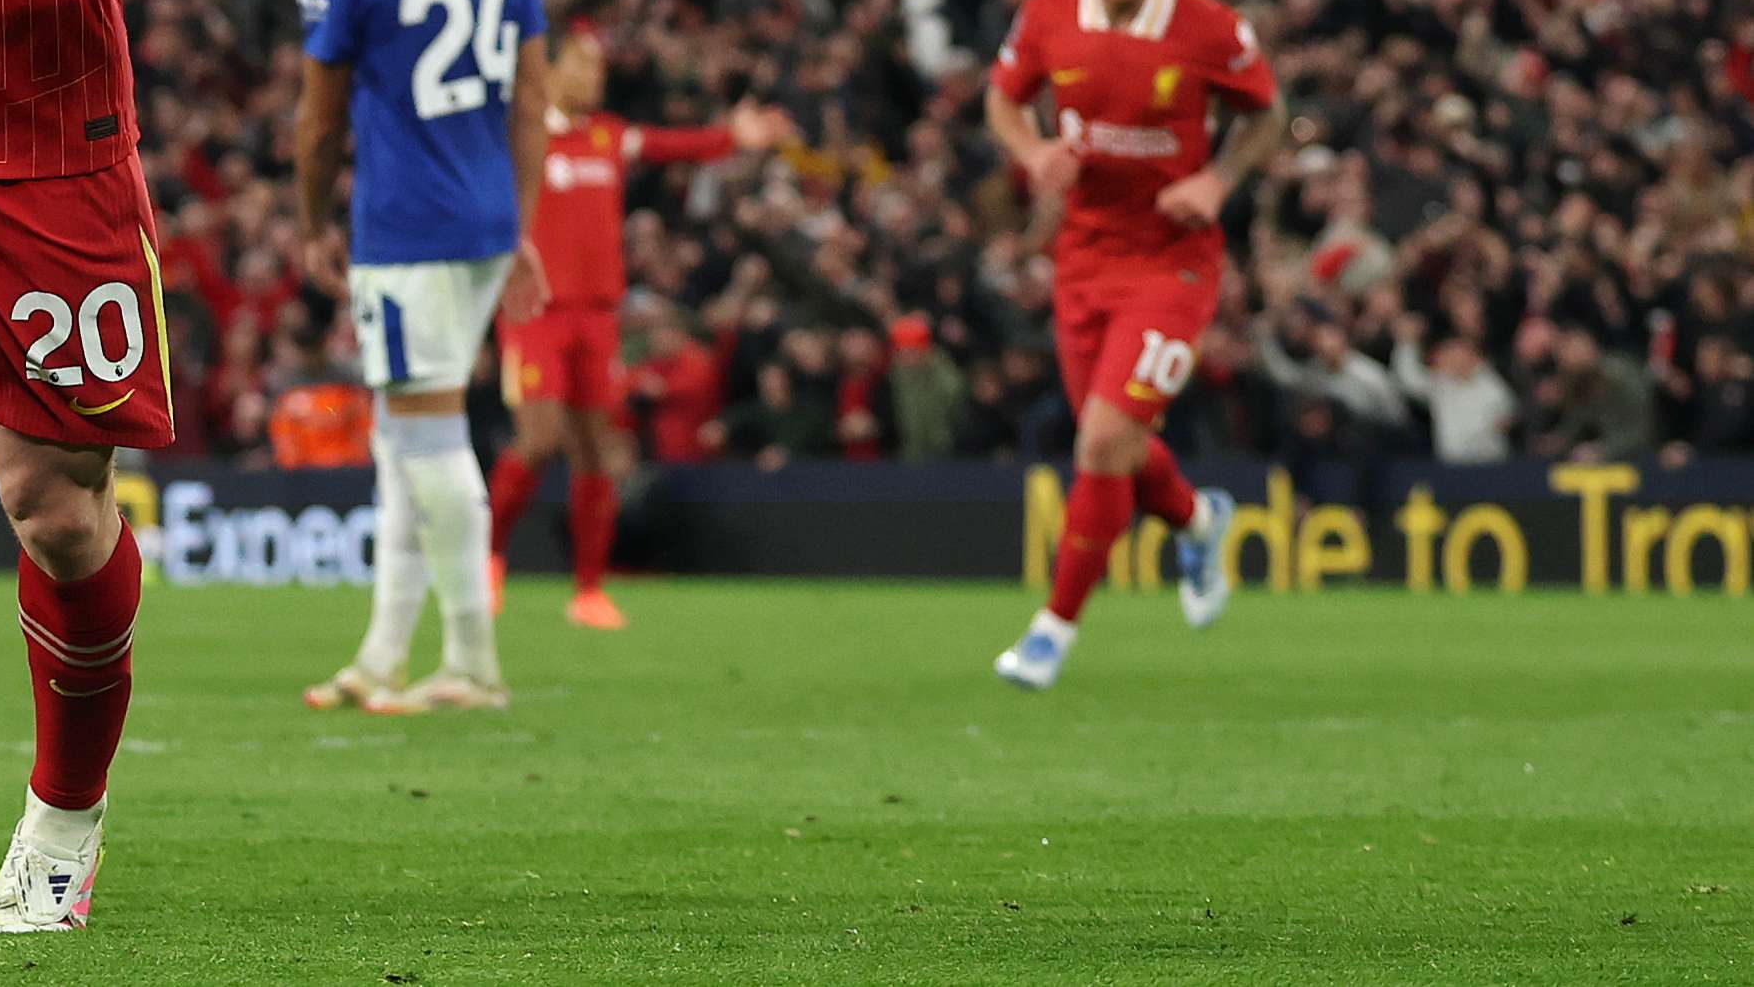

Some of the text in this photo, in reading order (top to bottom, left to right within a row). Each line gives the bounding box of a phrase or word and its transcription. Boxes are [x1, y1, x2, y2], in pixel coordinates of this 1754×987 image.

[11, 281, 144, 387] 20
[1134, 328, 1195, 396] 10
[1397, 484, 1530, 595] to
[1548, 463, 1754, 597] Tra
